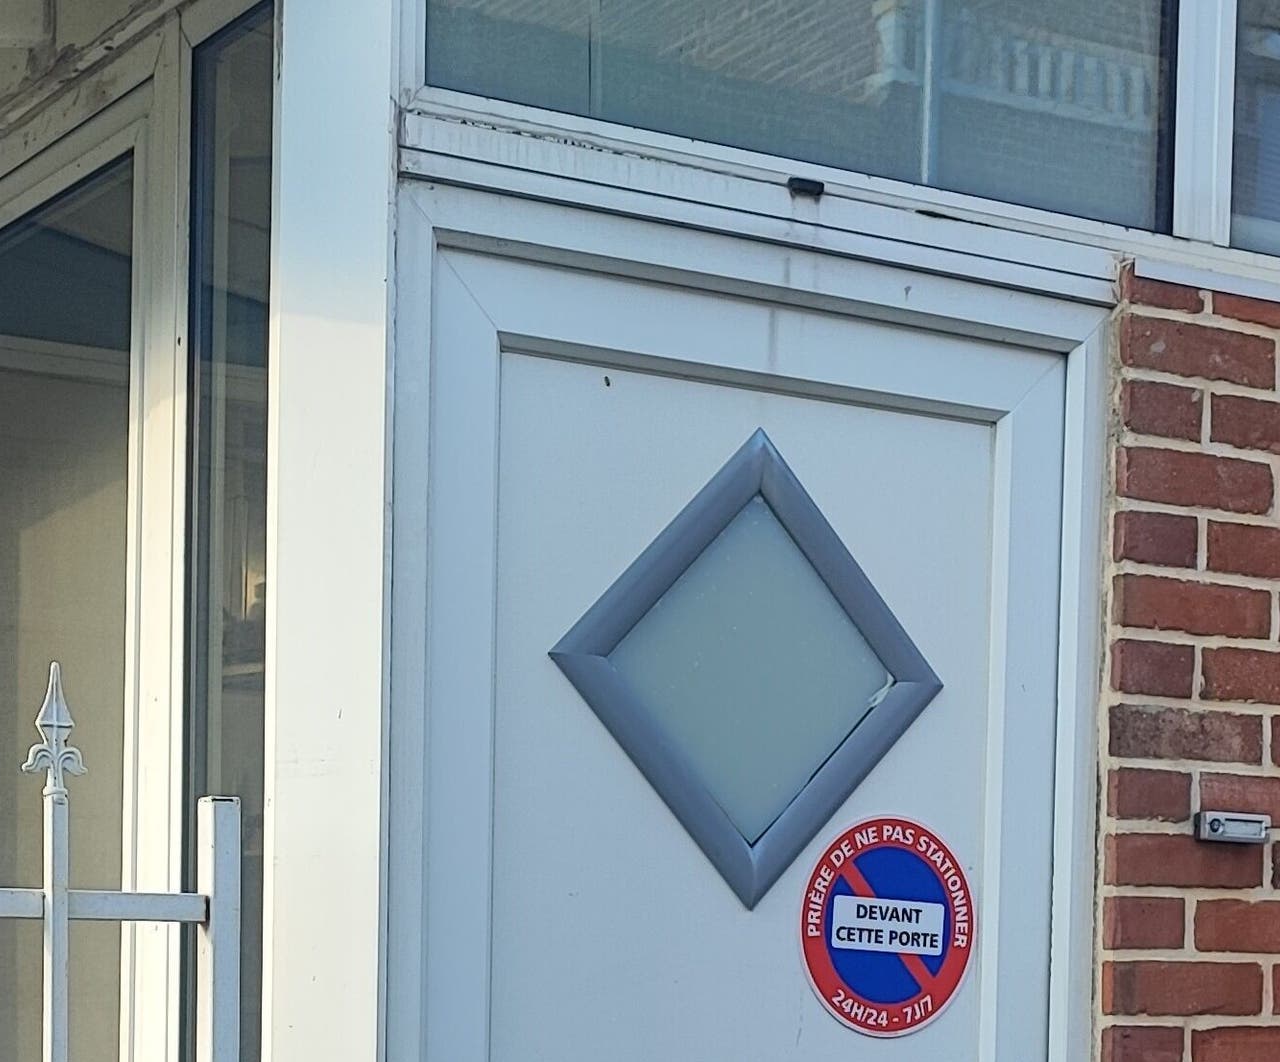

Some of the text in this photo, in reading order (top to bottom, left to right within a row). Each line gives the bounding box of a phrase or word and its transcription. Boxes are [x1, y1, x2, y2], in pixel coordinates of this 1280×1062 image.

[808, 825, 968, 948] PRIÈRE DE NE PAS STATIONNER
[856, 904, 923, 924] DEVANT
[836, 926, 938, 948] CETTE PORTE
[832, 989, 888, 1027] 24H/24
[903, 995, 932, 1023] 7J/7
